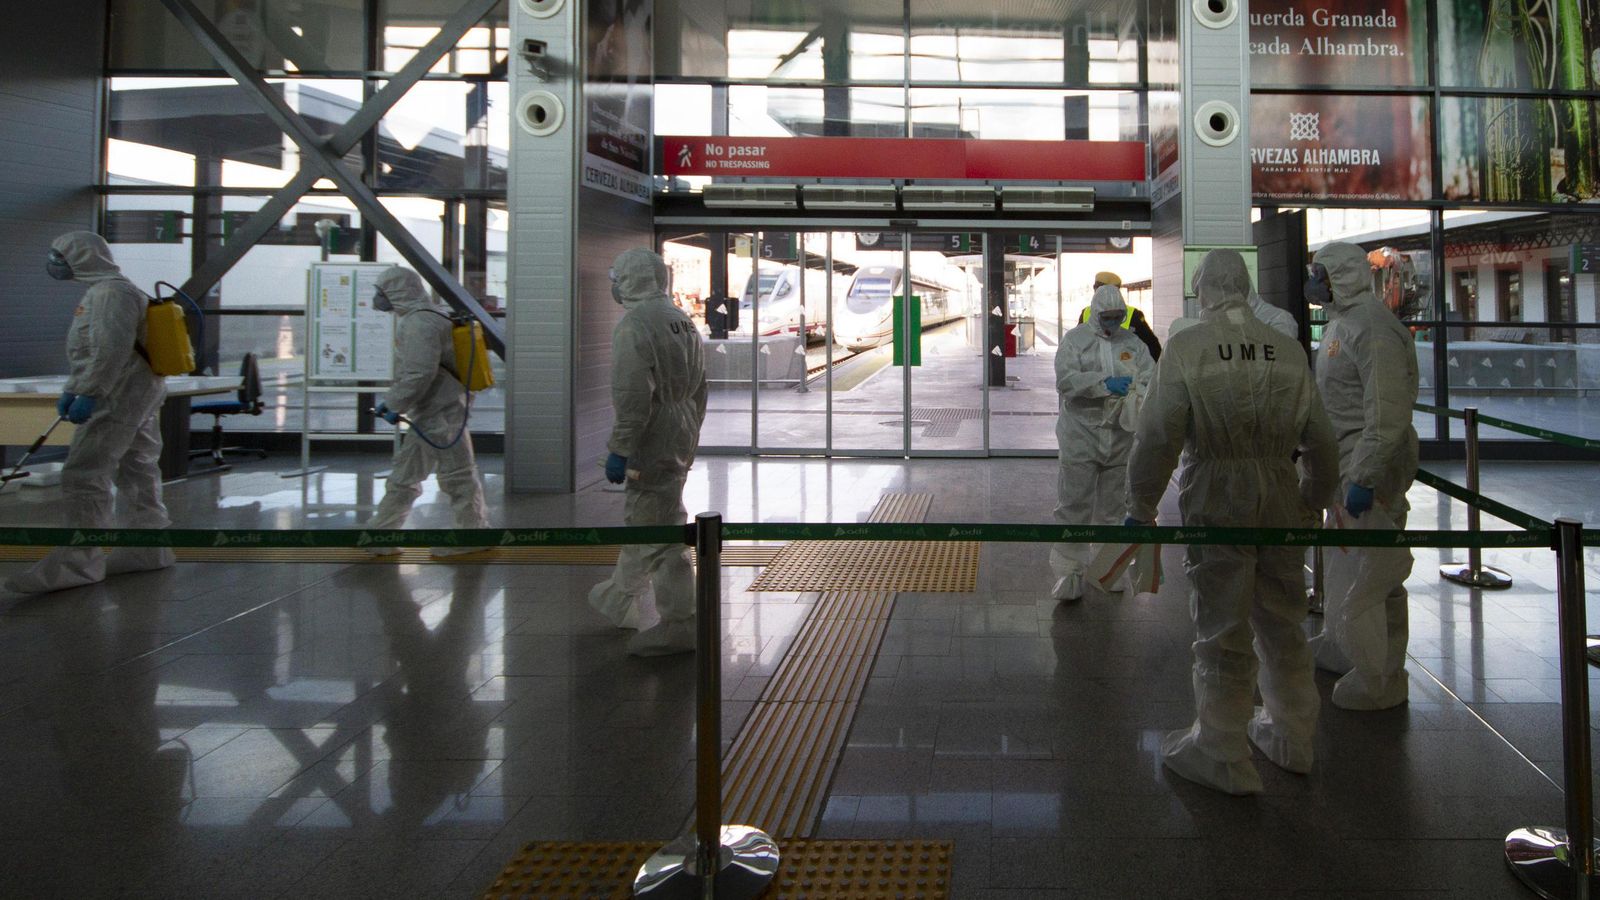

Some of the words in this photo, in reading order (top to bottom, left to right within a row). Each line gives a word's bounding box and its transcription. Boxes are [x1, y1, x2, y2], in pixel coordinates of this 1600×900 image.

[1312, 8, 1397, 28] Granada
[1249, 36, 1291, 55] cada
[1299, 37, 1405, 56] Alhambra.
[705, 143, 724, 156] No
[728, 145, 766, 158] pasar
[1303, 149, 1381, 165] ALHAMBRA
[705, 160, 718, 168] NO
[720, 160, 770, 169] TRESPASSING
[586, 167, 618, 190] CERVEZAS
[951, 235, 960, 248] 5
[1030, 235, 1039, 248] 4
[765, 244, 773, 257] 5
[1582, 258, 1589, 270] 2
[1218, 343, 1275, 361] UME
[517, 531, 549, 541] adif
